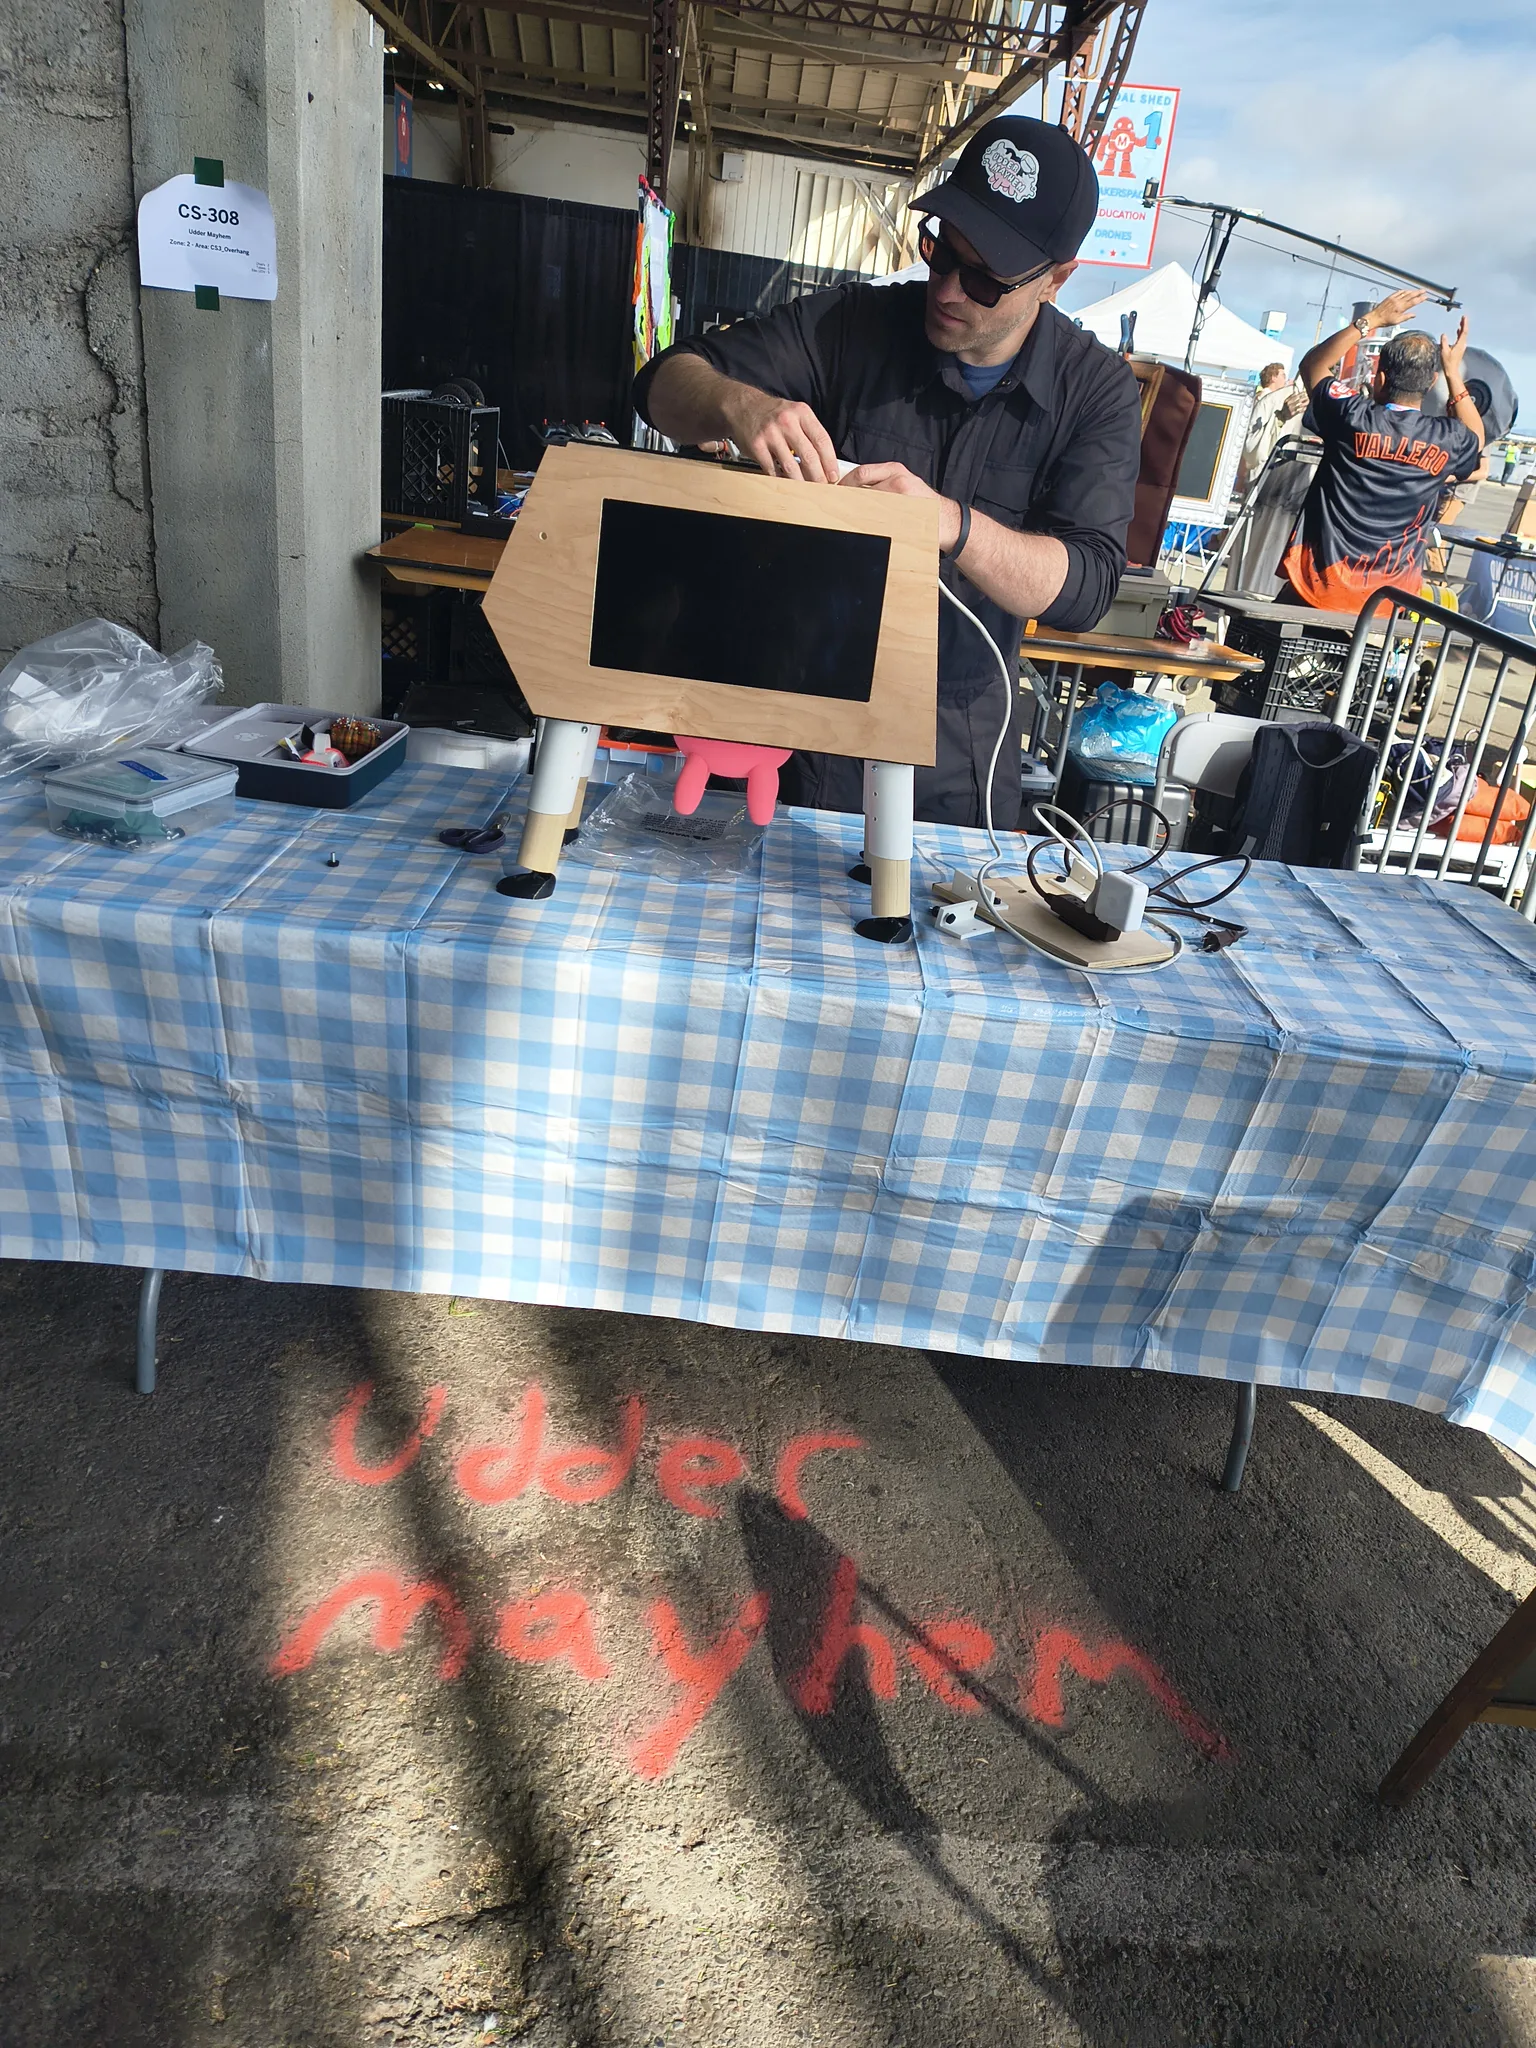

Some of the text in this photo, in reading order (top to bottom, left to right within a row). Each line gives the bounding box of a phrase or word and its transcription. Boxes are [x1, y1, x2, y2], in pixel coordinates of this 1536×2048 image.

[1139, 94, 1172, 106] SHED
[989, 163, 1027, 193] MAYHEM
[178, 203, 240, 226] CS-308
[1097, 208, 1147, 221] DUCATION
[188, 228, 232, 240] Udder Mayhem
[1094, 228, 1133, 241] DRONES
[169, 238, 186, 247] Zone:
[195, 242, 210, 250] Area:
[1355, 432, 1449, 476] VALLERO
[333, 1384, 866, 1521] Udder
